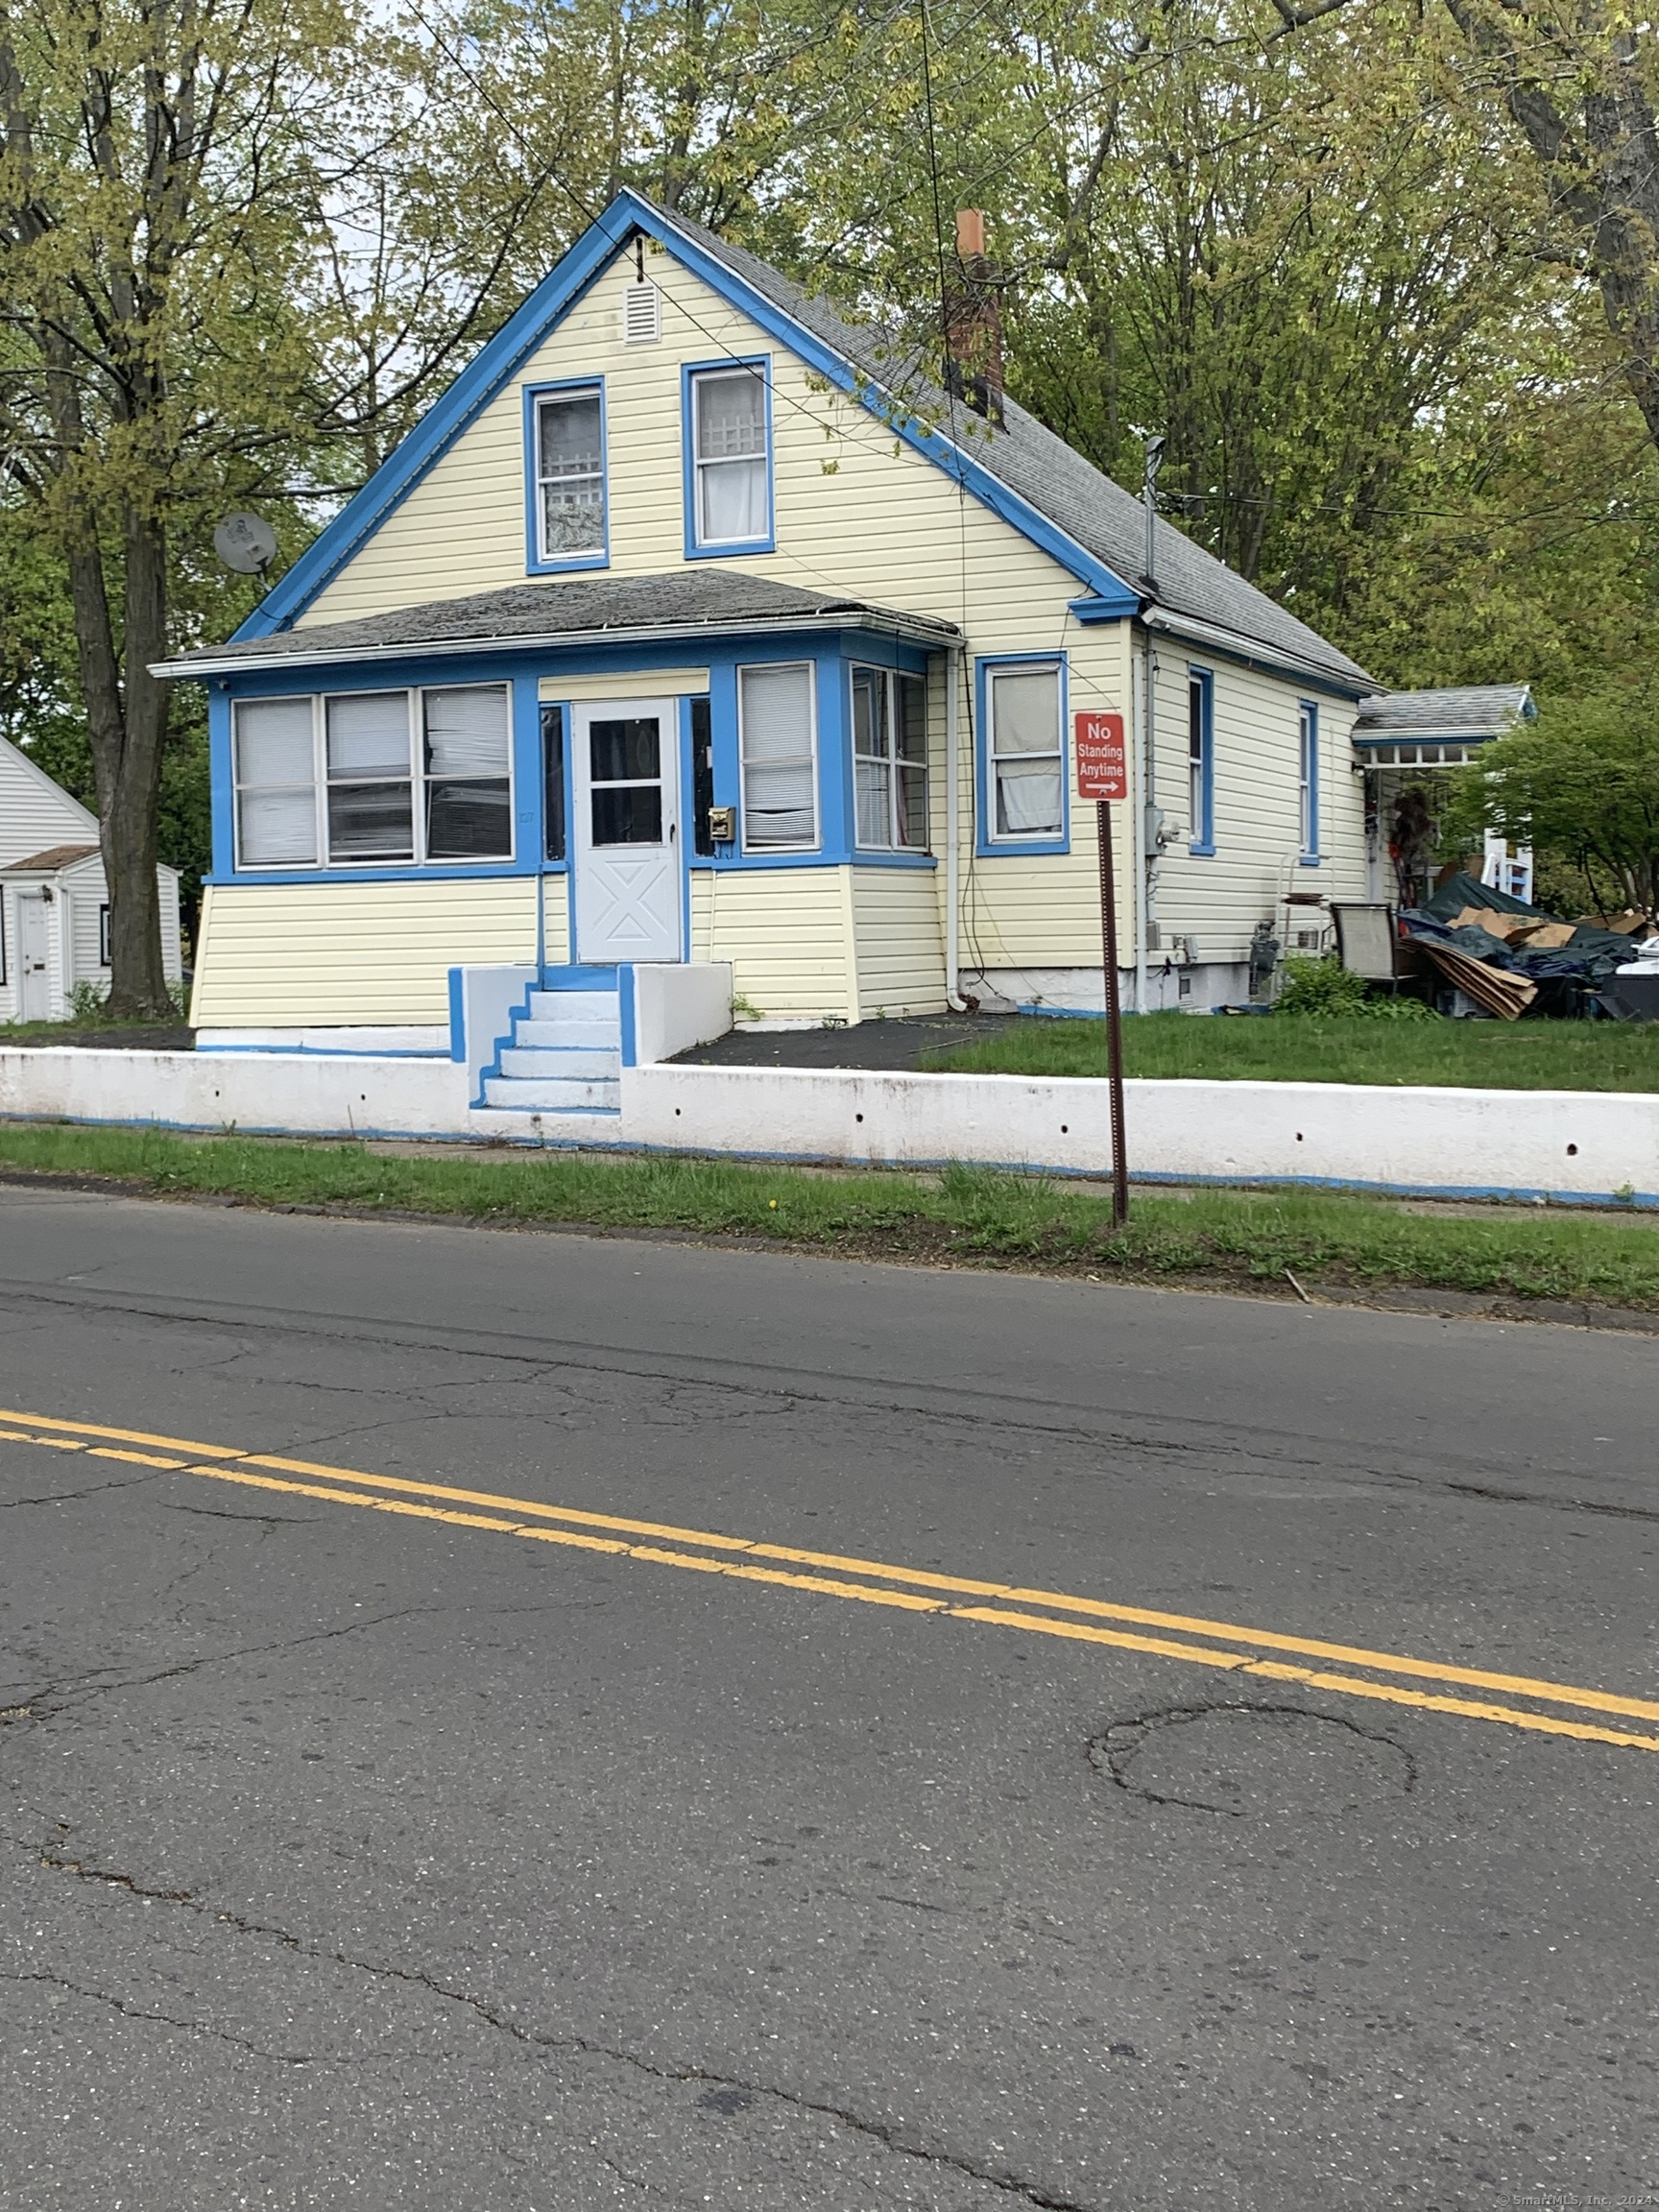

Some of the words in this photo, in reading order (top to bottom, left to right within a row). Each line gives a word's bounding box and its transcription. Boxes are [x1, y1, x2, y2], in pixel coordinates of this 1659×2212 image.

[1087, 722, 1112, 739] No
[1078, 743, 1123, 760] Standing
[1080, 761, 1123, 779] Anytime
